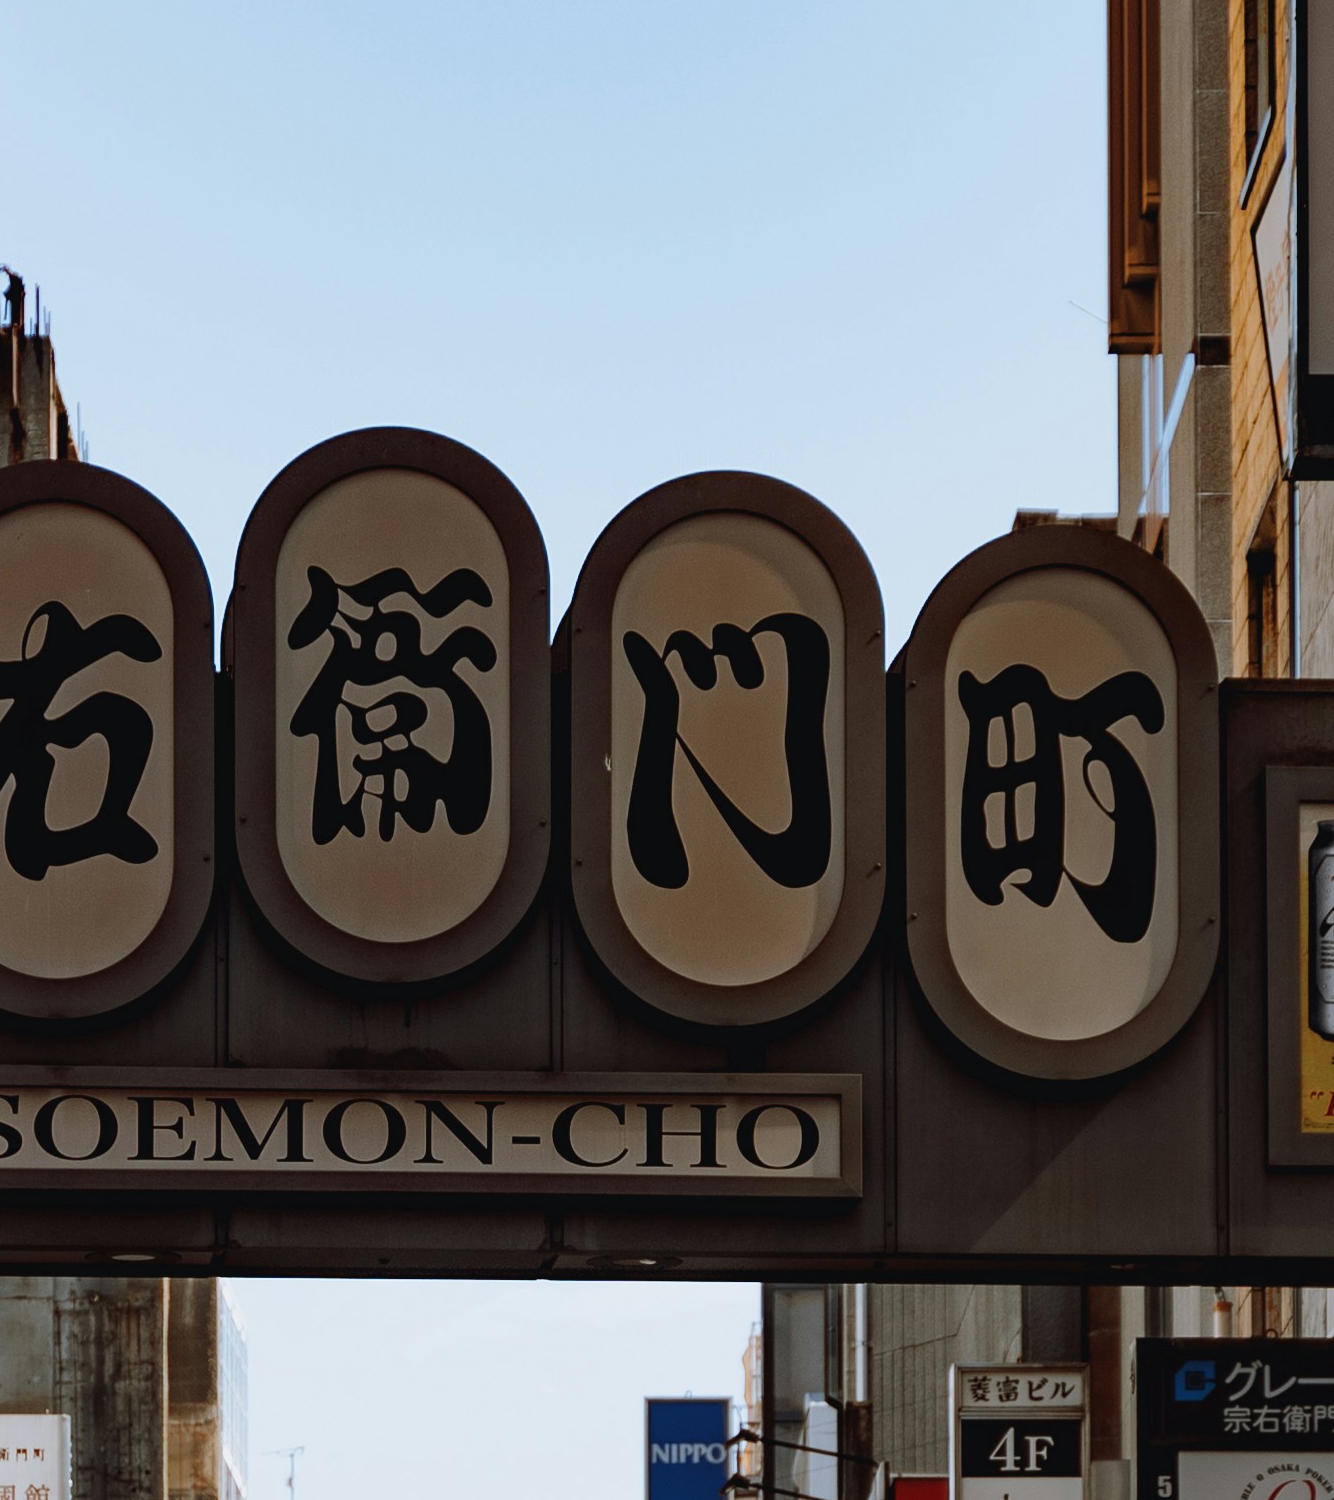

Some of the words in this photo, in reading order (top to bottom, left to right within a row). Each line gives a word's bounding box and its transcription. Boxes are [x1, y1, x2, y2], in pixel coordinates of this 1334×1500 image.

[967, 1377, 1076, 1404] 菱富ビル
[989, 1426, 1055, 1472] 4F
[1267, 1463, 1301, 1476] OSAKA
